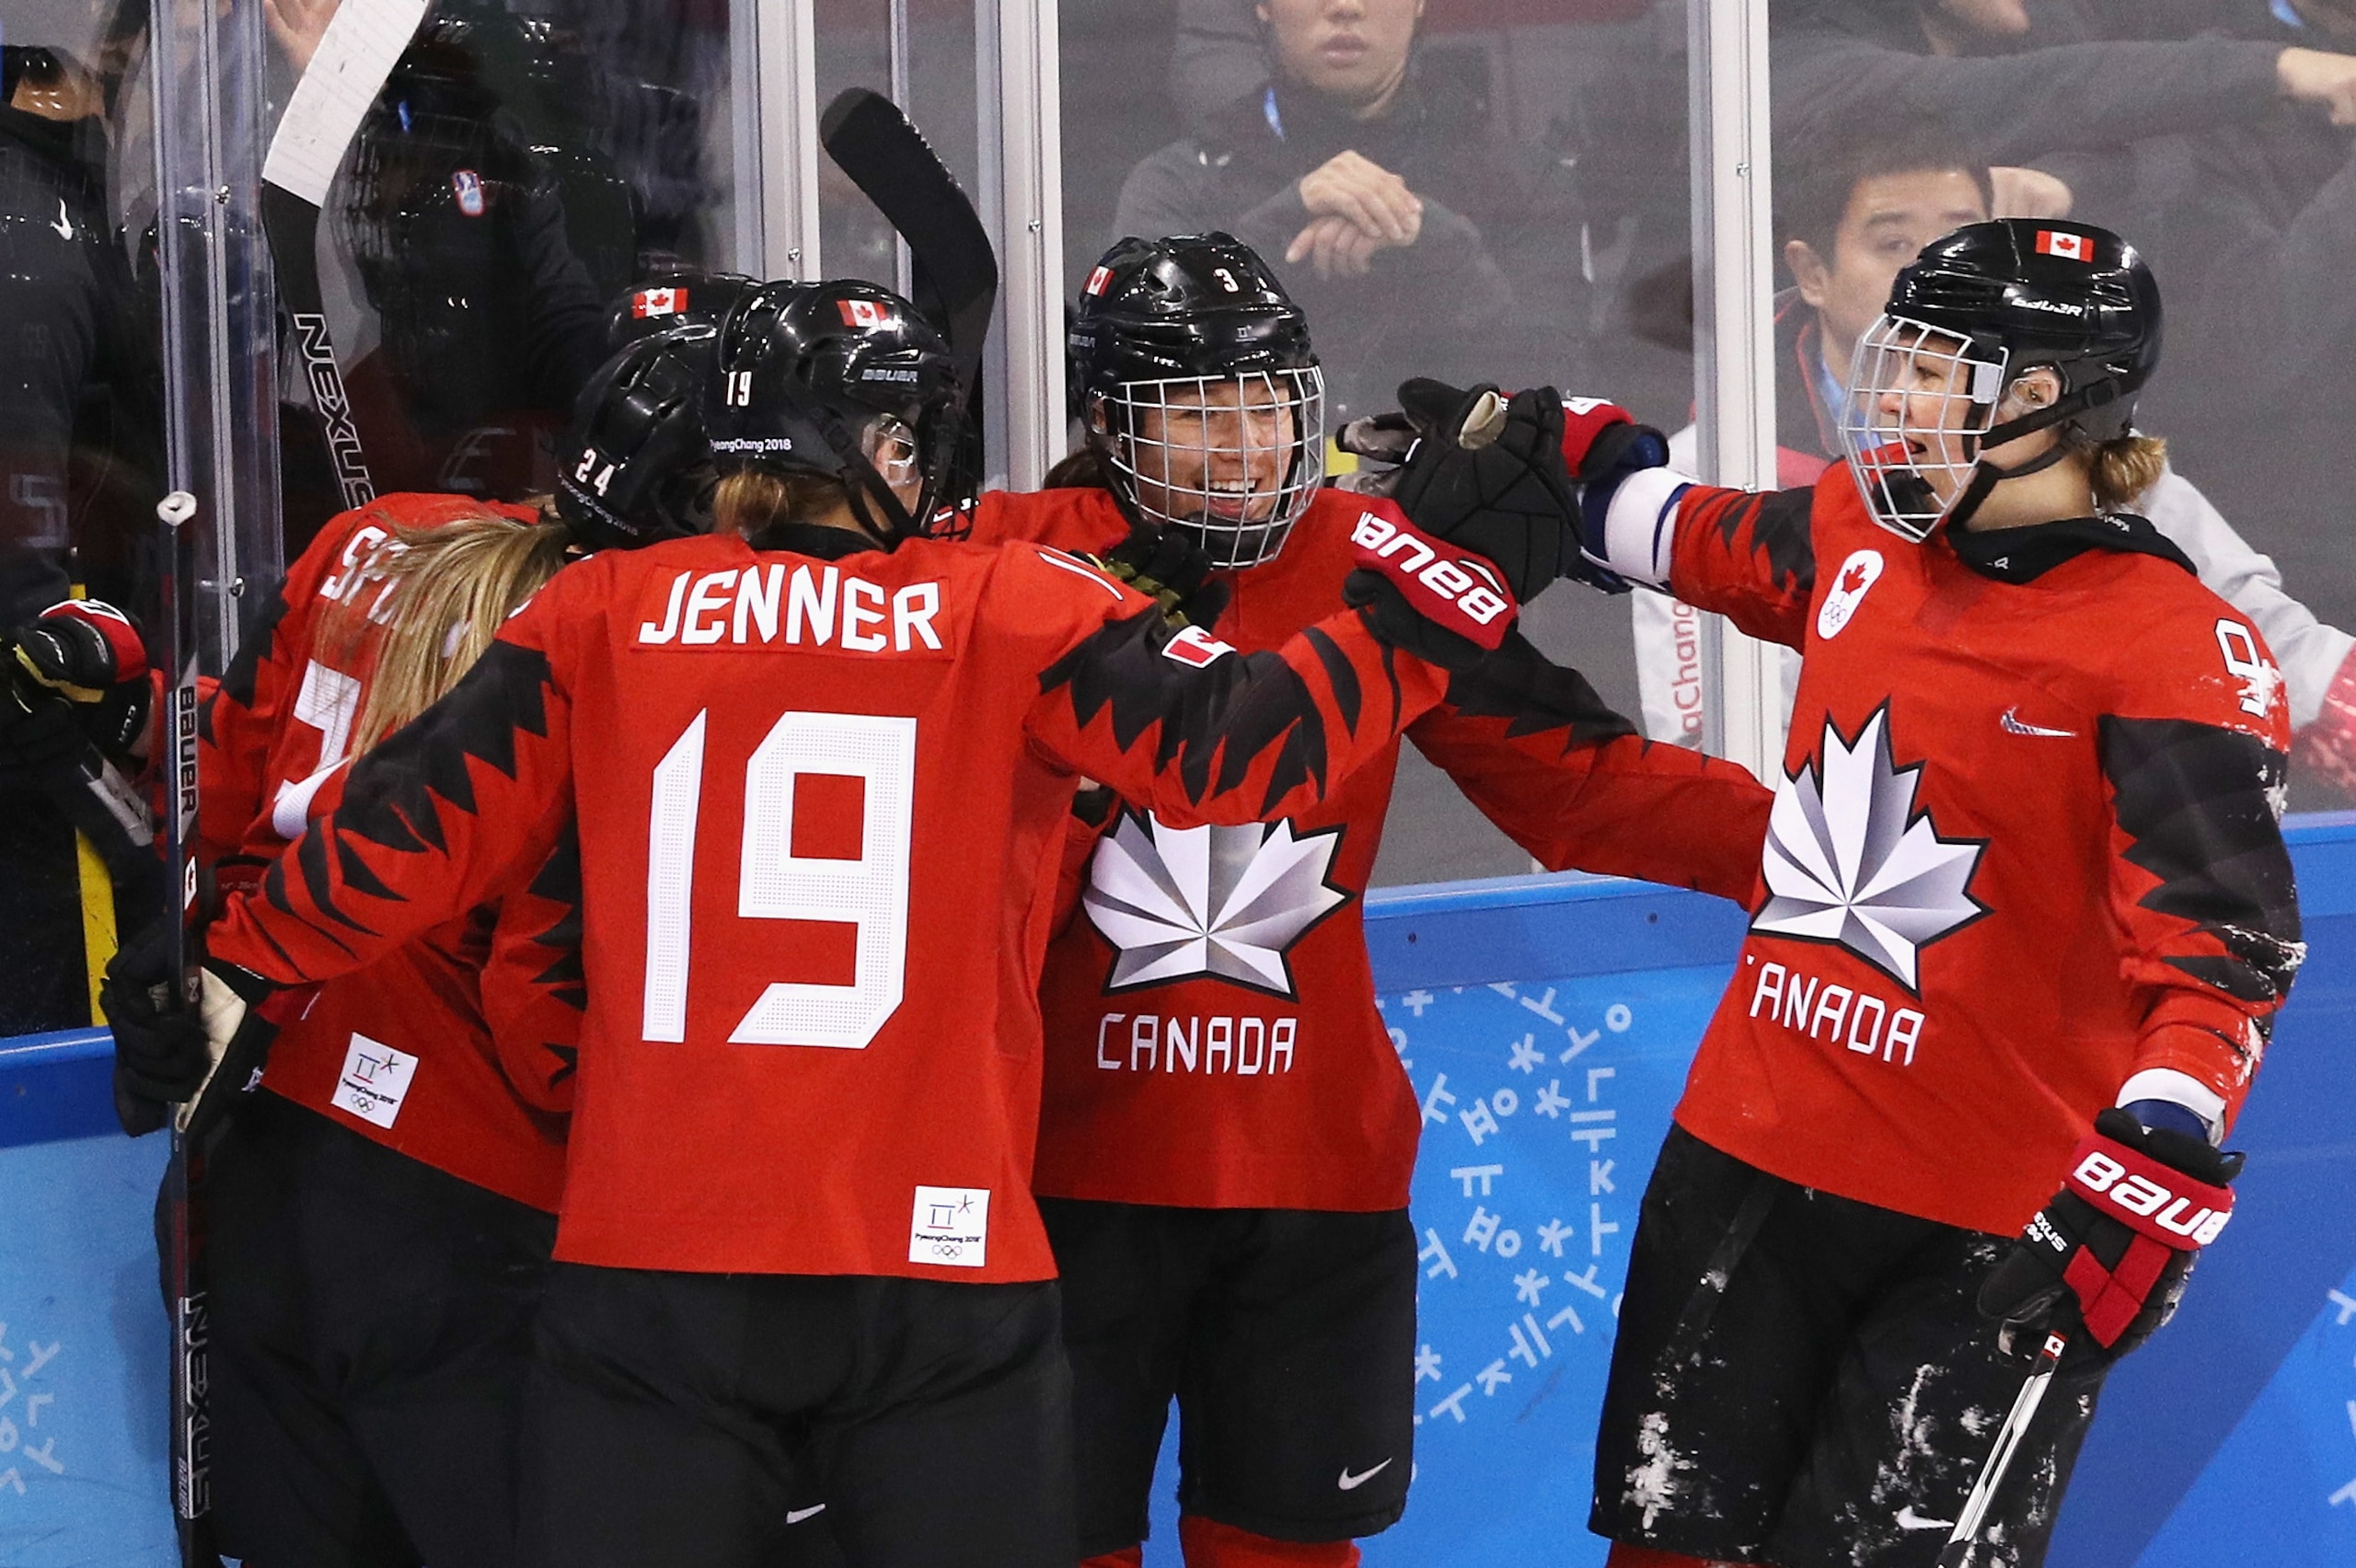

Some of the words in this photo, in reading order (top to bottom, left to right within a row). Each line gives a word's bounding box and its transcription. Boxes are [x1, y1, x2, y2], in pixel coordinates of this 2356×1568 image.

[1214, 268, 1240, 294] 3
[726, 370, 753, 407] 19
[574, 448, 616, 497] 24
[764, 438, 792, 451] 2018
[638, 563, 943, 652] JENNER
[179, 686, 195, 815] BAUER
[641, 707, 918, 1050] 19
[1746, 953, 1925, 1067] ANADA
[1096, 1012, 1298, 1076] CANADA
